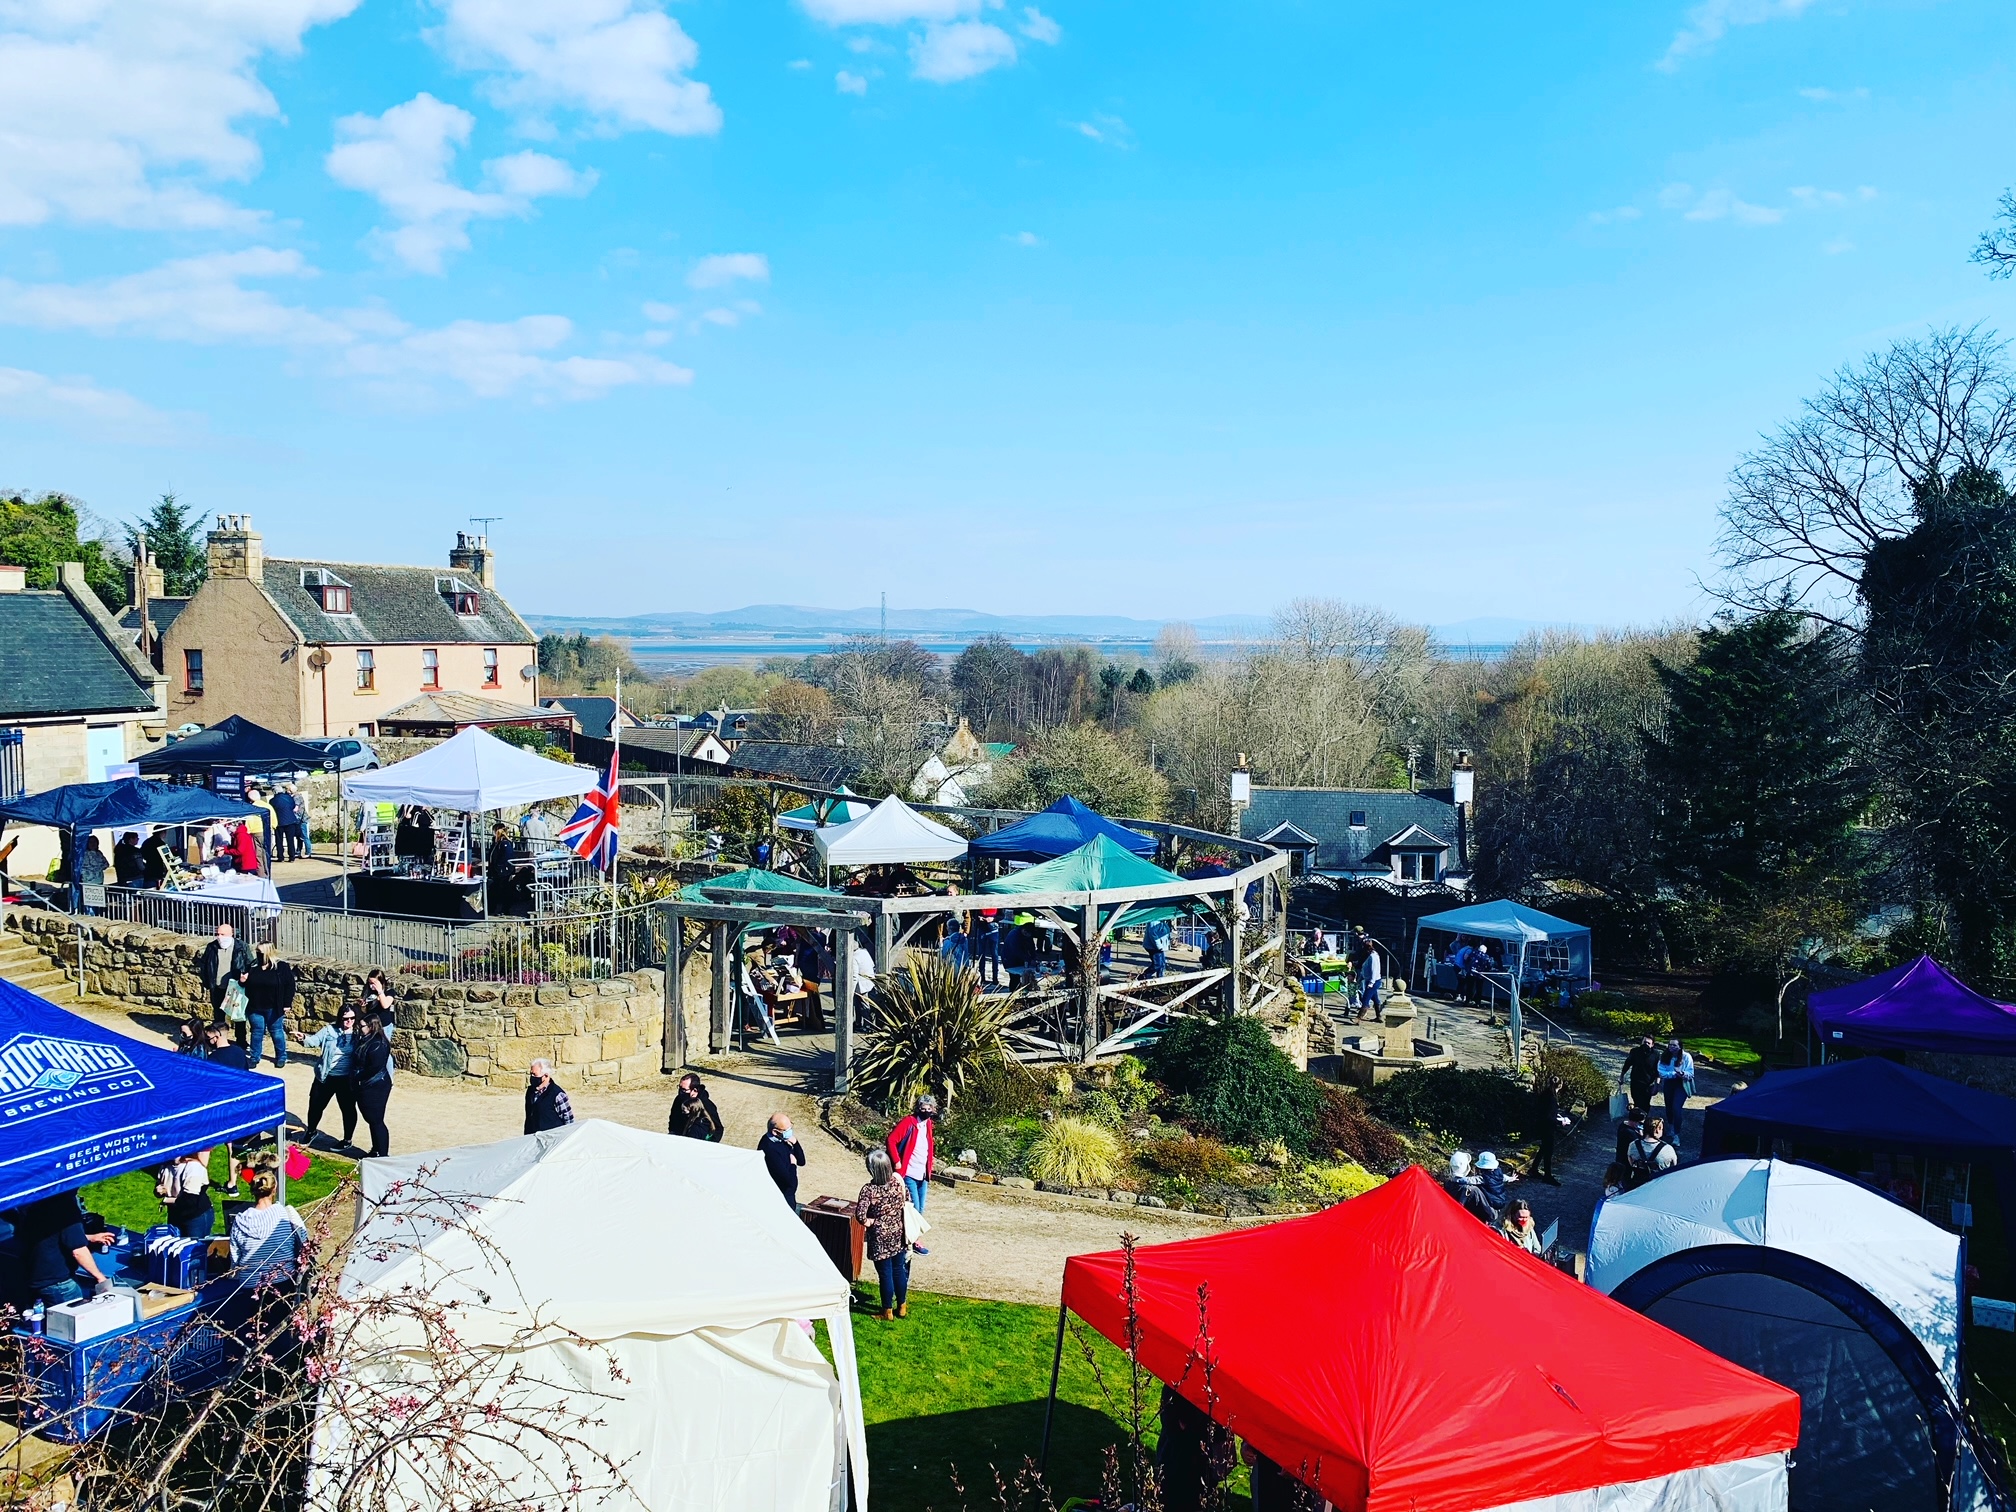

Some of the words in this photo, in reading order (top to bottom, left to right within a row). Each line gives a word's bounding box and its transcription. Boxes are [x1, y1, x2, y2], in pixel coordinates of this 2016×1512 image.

[4, 1086, 101, 1117] BREWING
[107, 1079, 140, 1090] CO.
[66, 1145, 131, 1170] BELIEVING
[136, 1141, 148, 1149] IN
[69, 1145, 100, 1160] BEER
[104, 1133, 145, 1149] WORTH
